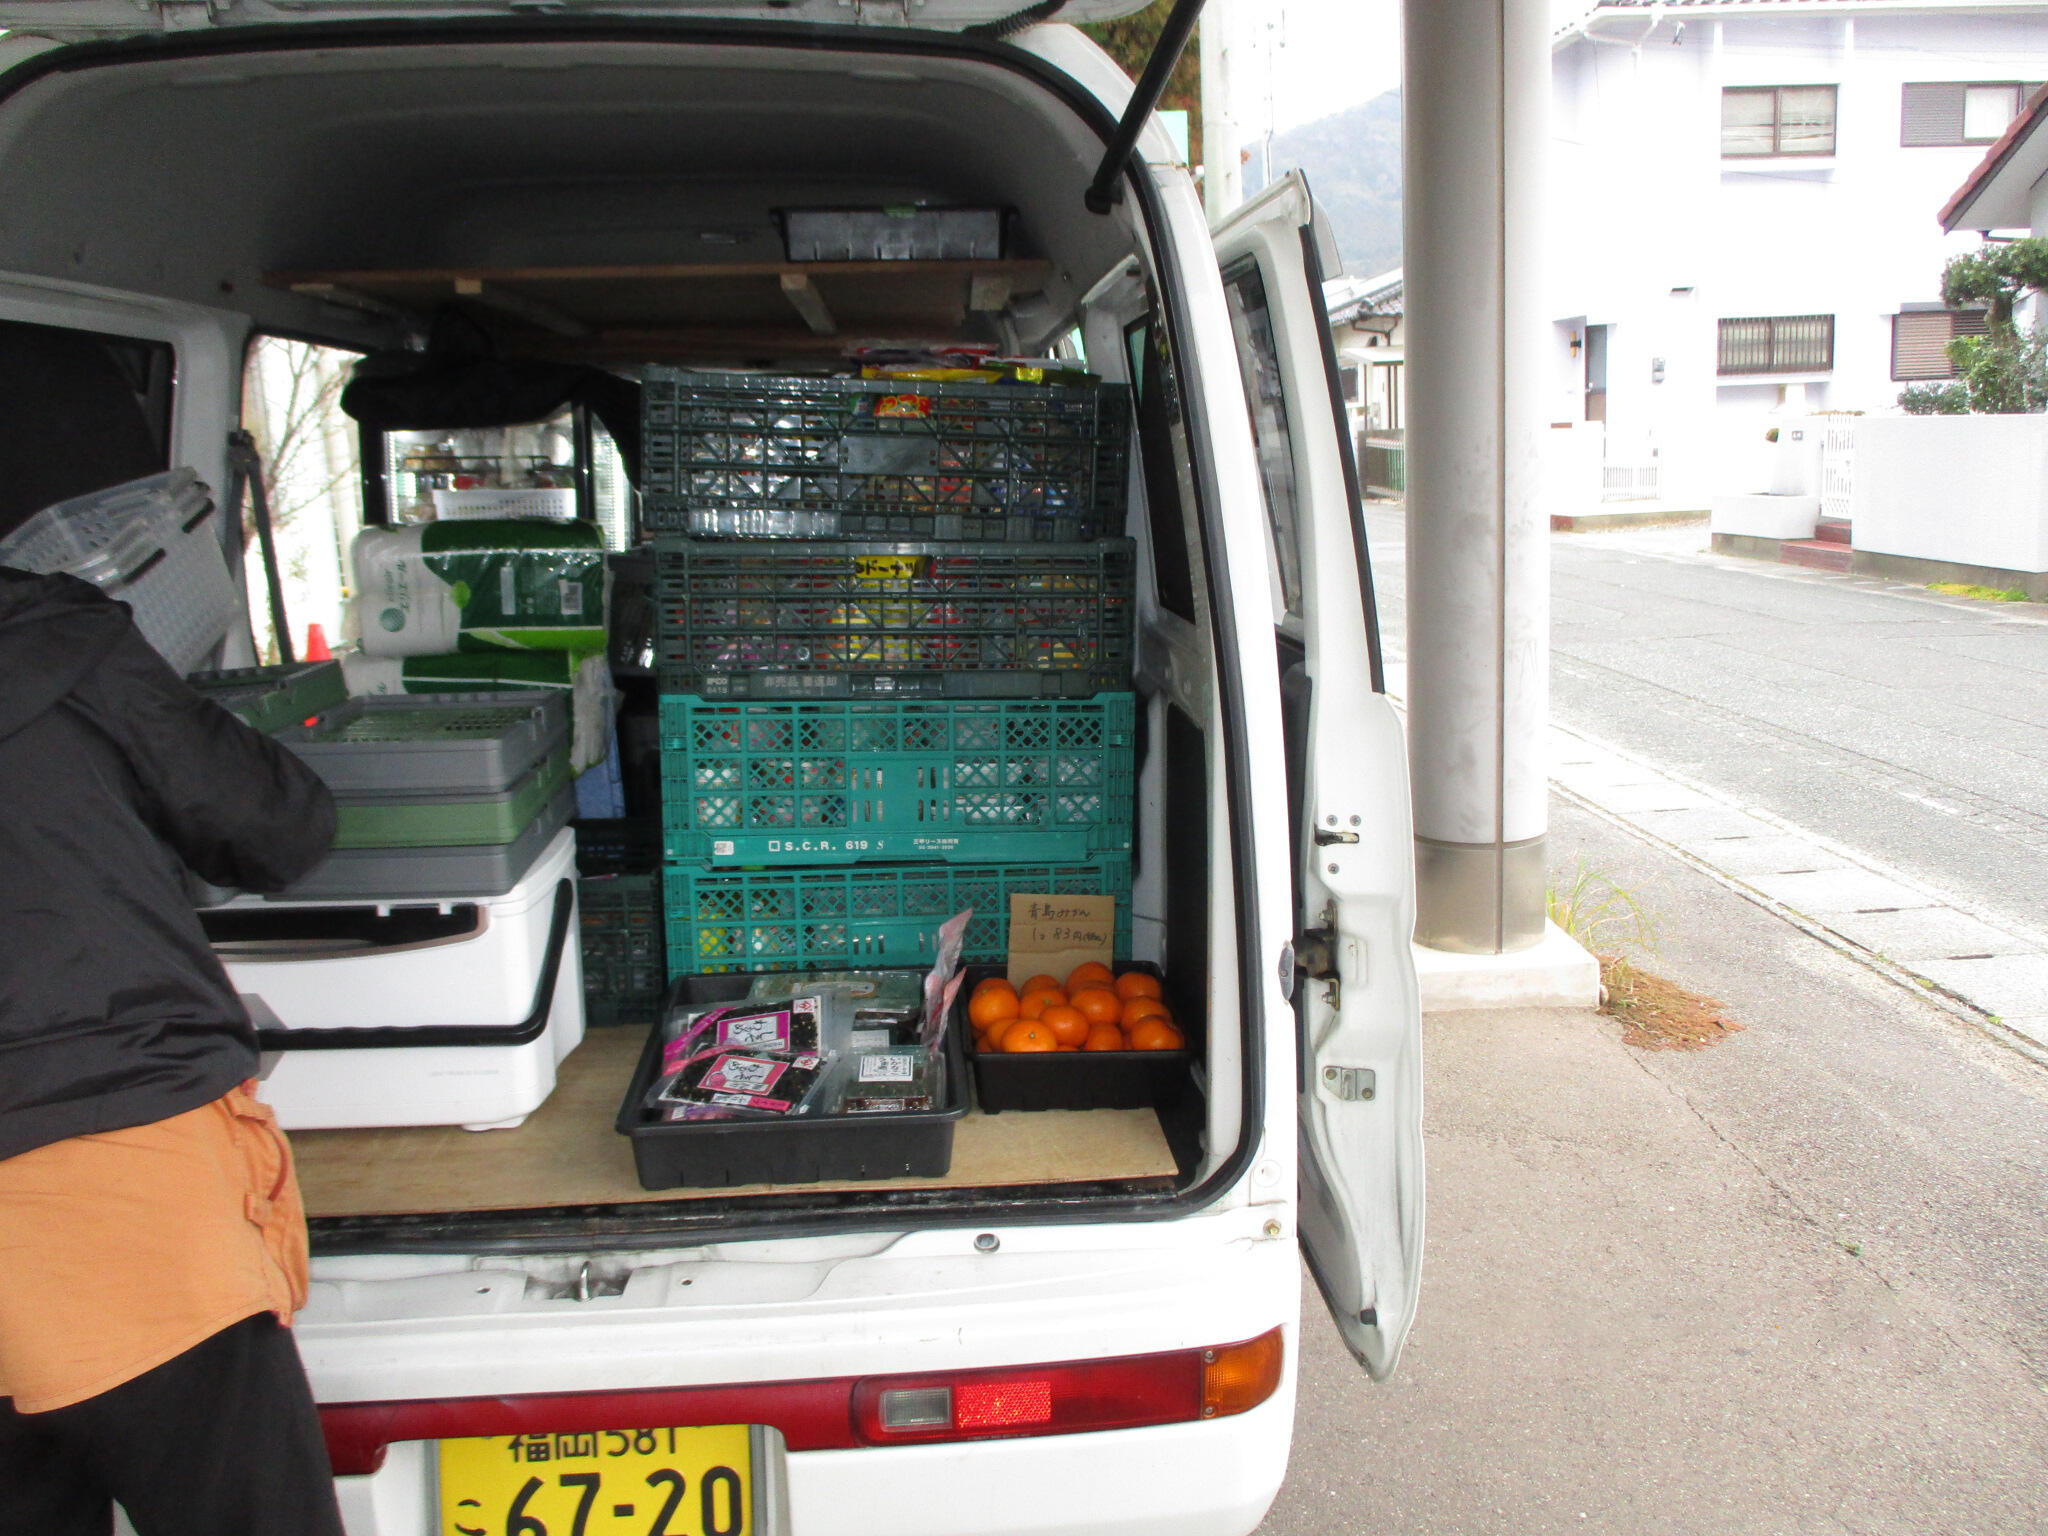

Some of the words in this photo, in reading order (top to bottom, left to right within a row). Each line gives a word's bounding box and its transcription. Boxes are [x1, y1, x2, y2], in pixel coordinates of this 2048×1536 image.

[784, 840, 836, 851] S.C.R.
[845, 840, 869, 850] 619
[505, 1465, 743, 1536] 67-20
